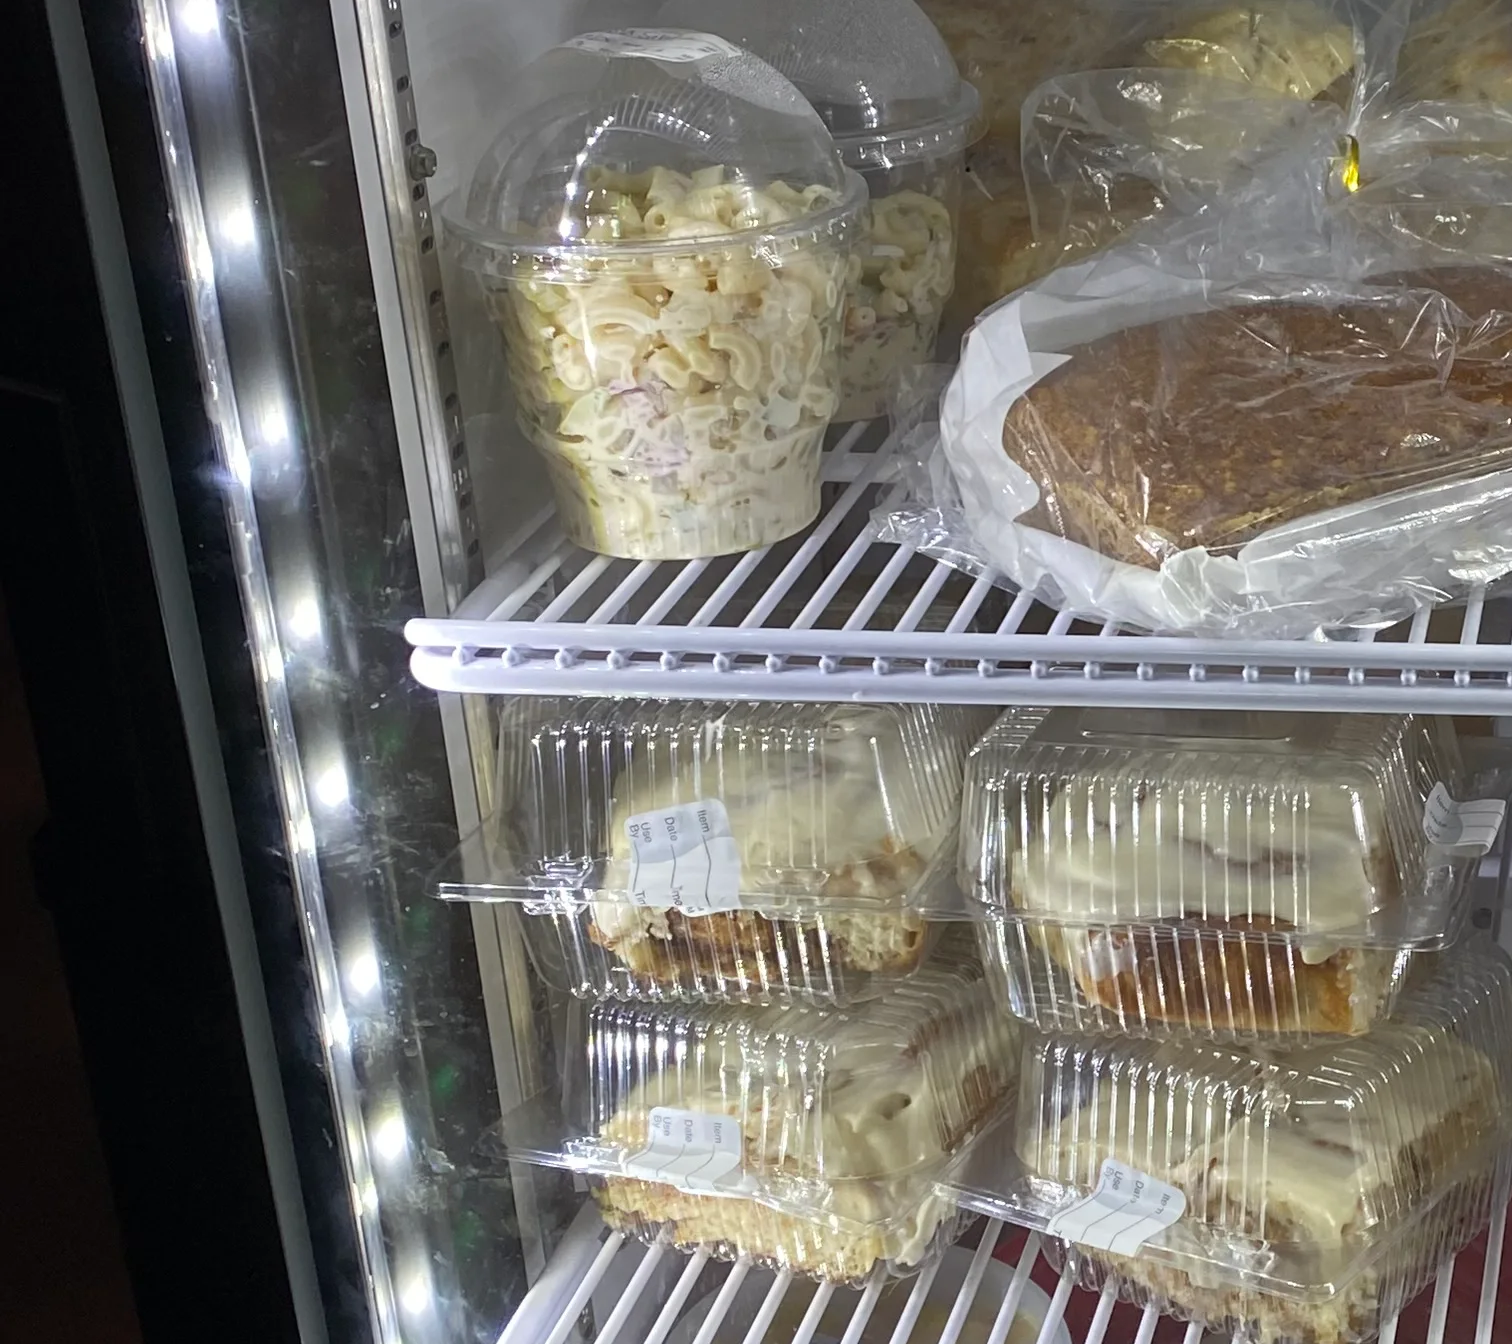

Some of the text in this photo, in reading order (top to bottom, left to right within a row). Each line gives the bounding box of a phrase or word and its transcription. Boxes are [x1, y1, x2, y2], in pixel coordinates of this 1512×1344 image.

[629, 824, 639, 839] By
[640, 822, 652, 844] Use
[664, 817, 679, 842] Date
[697, 810, 711, 834] Item
[652, 1115, 662, 1129] By
[662, 1116, 672, 1137] Use
[684, 1119, 694, 1143] Date
[713, 1122, 722, 1144] Item
[1111, 1170, 1124, 1191] Use
[1129, 1180, 1145, 1205] Date
[1155, 1193, 1172, 1216] Item
